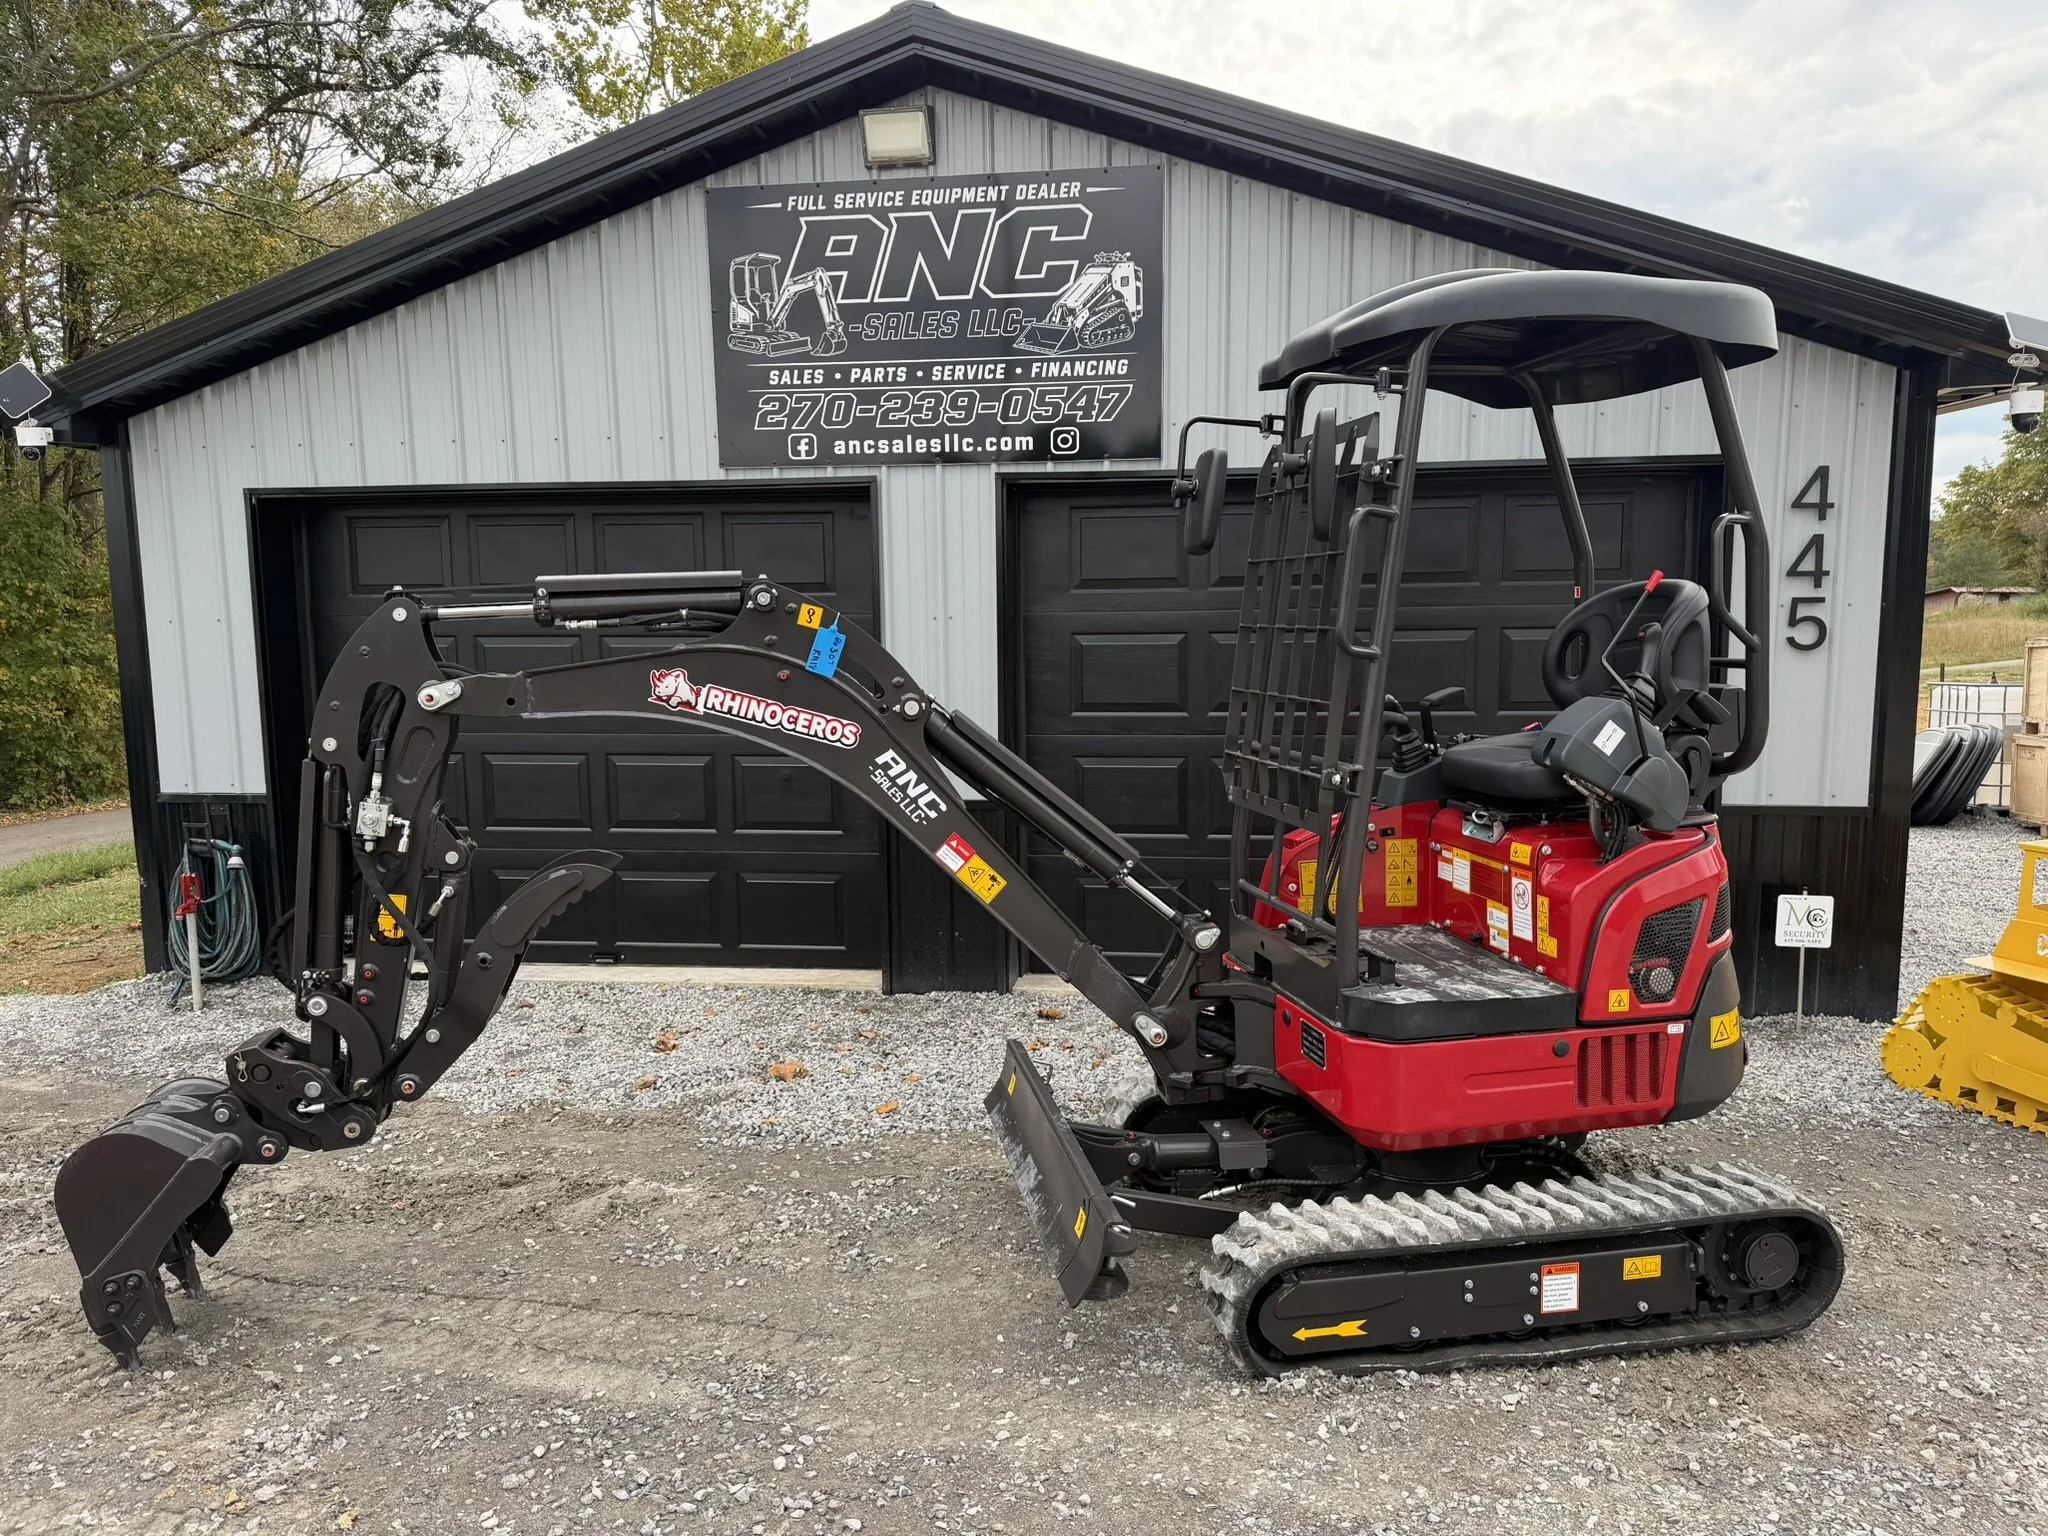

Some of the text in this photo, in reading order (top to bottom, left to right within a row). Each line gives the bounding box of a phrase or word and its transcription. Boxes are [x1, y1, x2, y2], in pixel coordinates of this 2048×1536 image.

[787, 182, 1081, 211] FULL SERVICE EQUIPMENT DEALER
[780, 204, 1093, 303] ANC
[769, 359, 1129, 386] SALES PARTS SERVICE FINANCING
[754, 385, 1133, 430] 270-239-0547
[833, 433, 1034, 456] ancsalesllc.com
[705, 686, 861, 747] RHINOCEROS
[874, 748, 947, 819] ANC
[1783, 930, 1827, 938] SECURITY
[1554, 1265, 1577, 1273] WARNING
